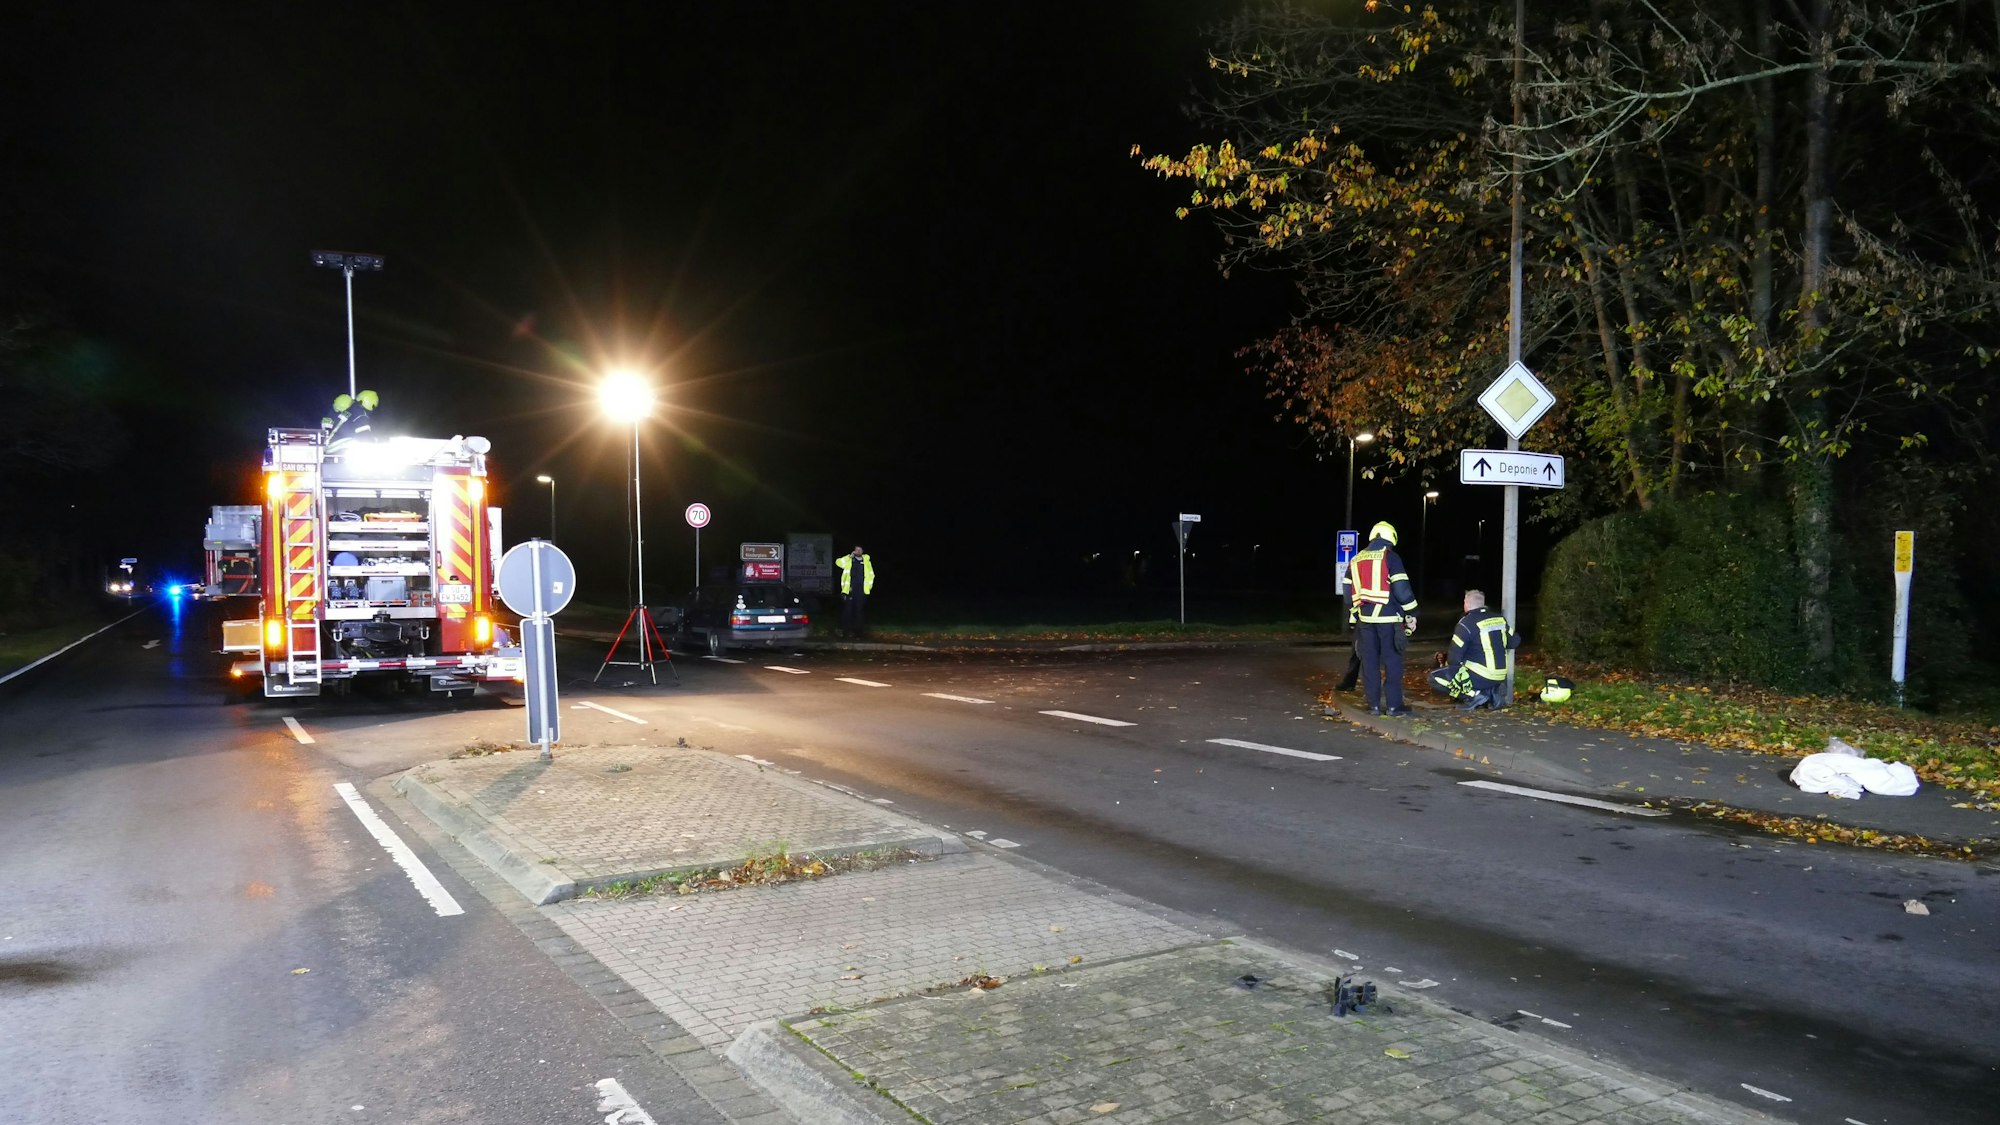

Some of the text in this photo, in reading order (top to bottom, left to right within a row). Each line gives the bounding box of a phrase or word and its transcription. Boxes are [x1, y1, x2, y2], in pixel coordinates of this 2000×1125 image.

[1499, 462, 1538, 477] Deponie
[692, 510, 705, 521] 70
[441, 593, 469, 601] FW 1452
